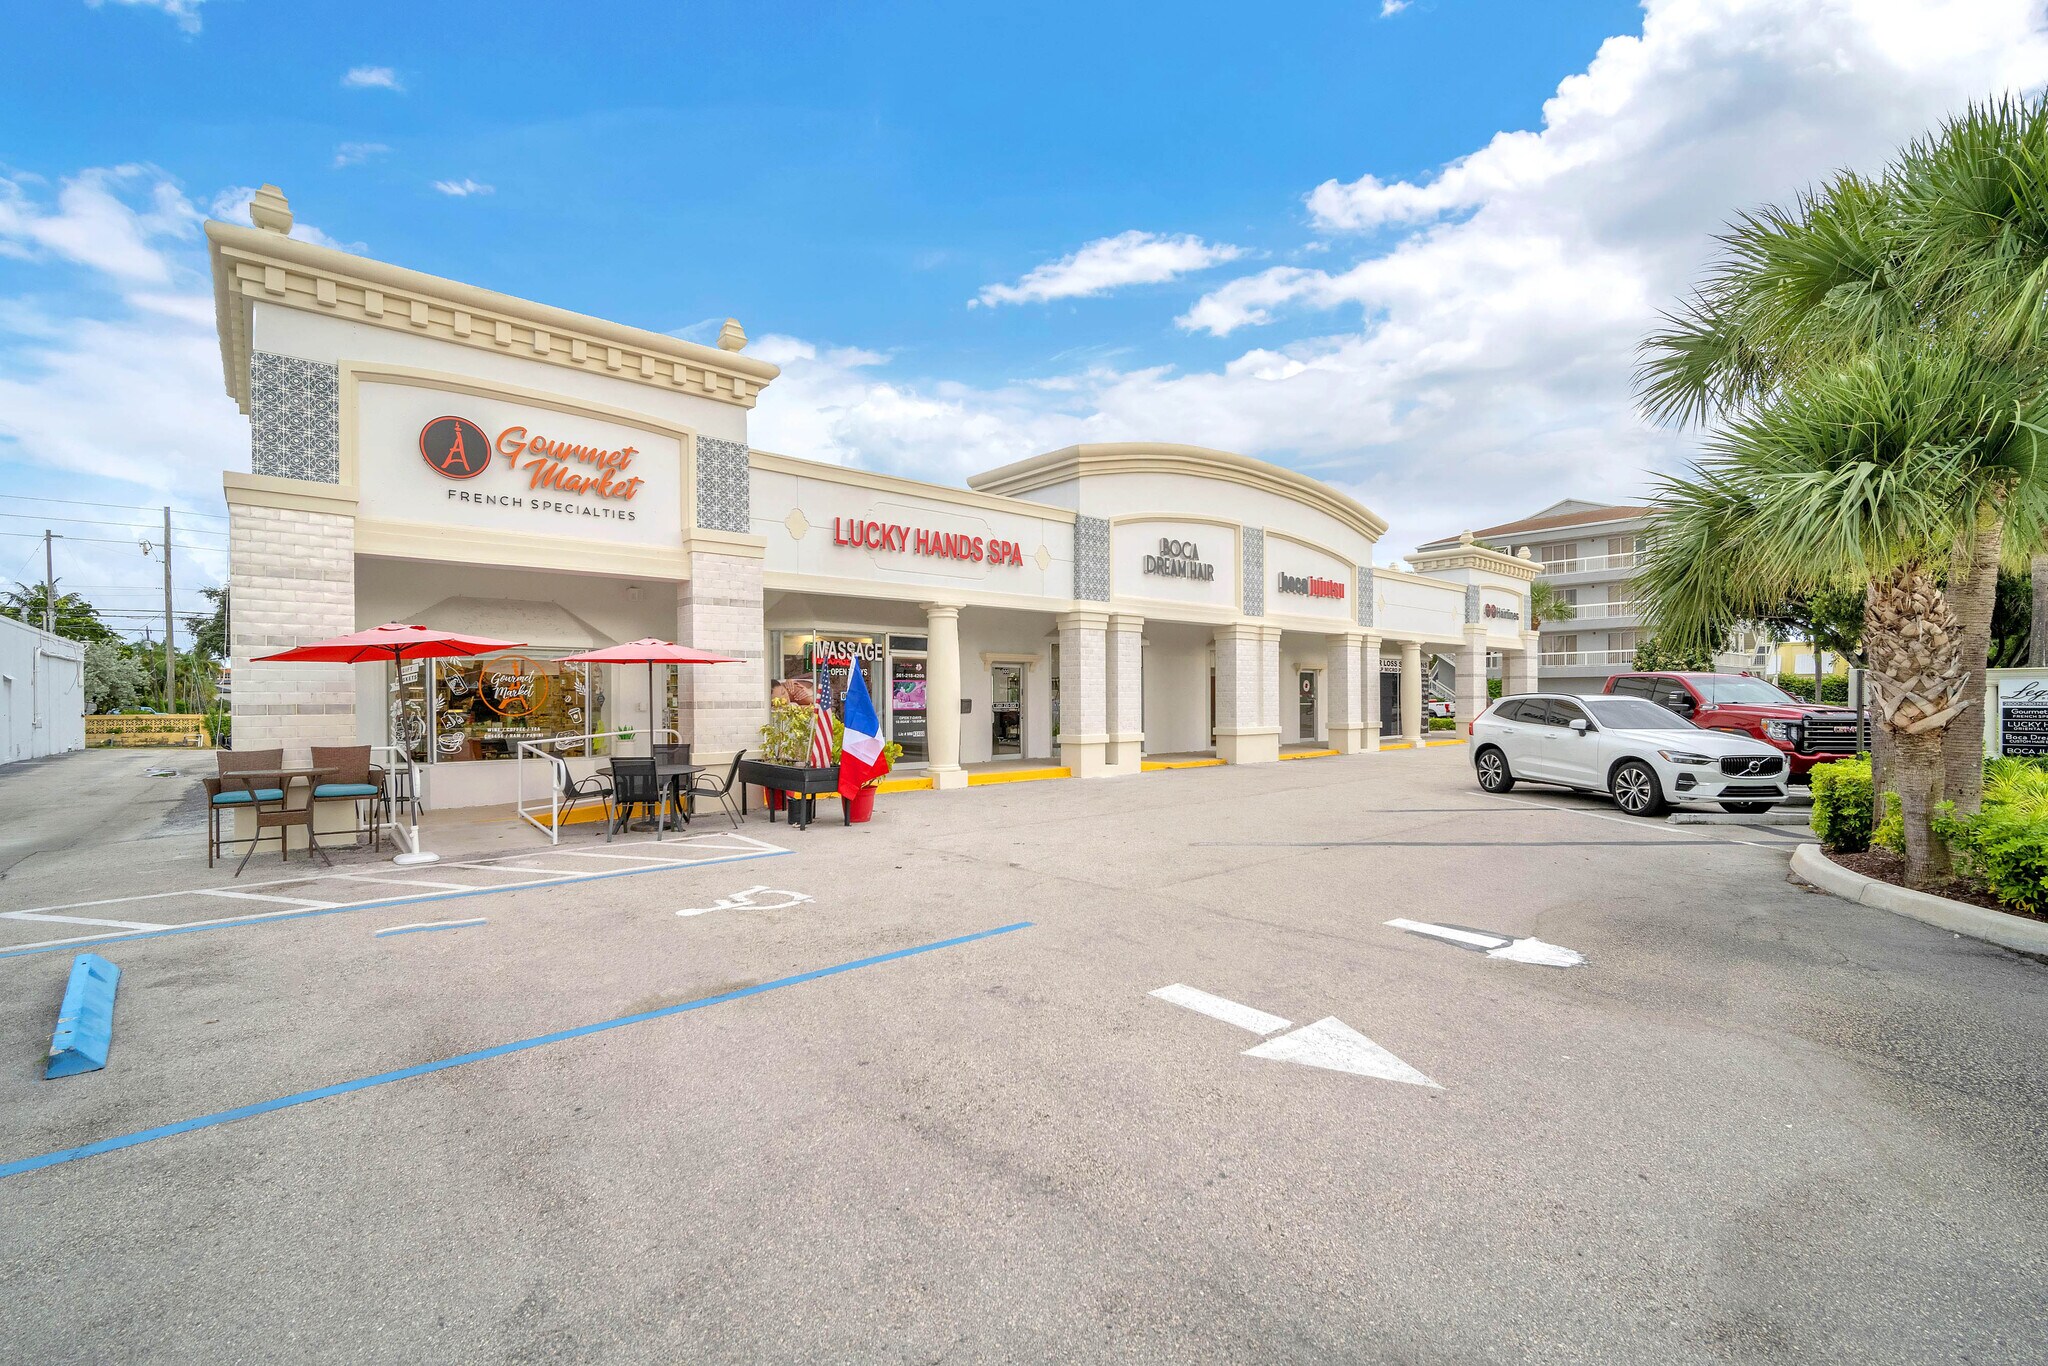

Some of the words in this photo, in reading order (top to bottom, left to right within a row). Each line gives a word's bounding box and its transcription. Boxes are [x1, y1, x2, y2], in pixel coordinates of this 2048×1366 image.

[496, 425, 640, 470] Gourmet
[523, 457, 645, 501] Market
[448, 489, 523, 508] FRENCH
[531, 499, 637, 522] SPECIALTIES
[834, 517, 911, 553] LUCKY
[915, 528, 984, 563] HANDS
[987, 538, 1024, 567] SPA
[1159, 537, 1200, 561] BOCA
[1143, 554, 1187, 580] DREAM
[1187, 561, 1215, 582] HAIR
[816, 640, 883, 662] MASSAGE
[830, 668, 848, 676] OPEN
[1383, 660, 1398, 668] LOSS
[491, 670, 534, 687] Gourmet
[492, 684, 534, 699] Market
[2006, 747, 2036, 755] BOCA
